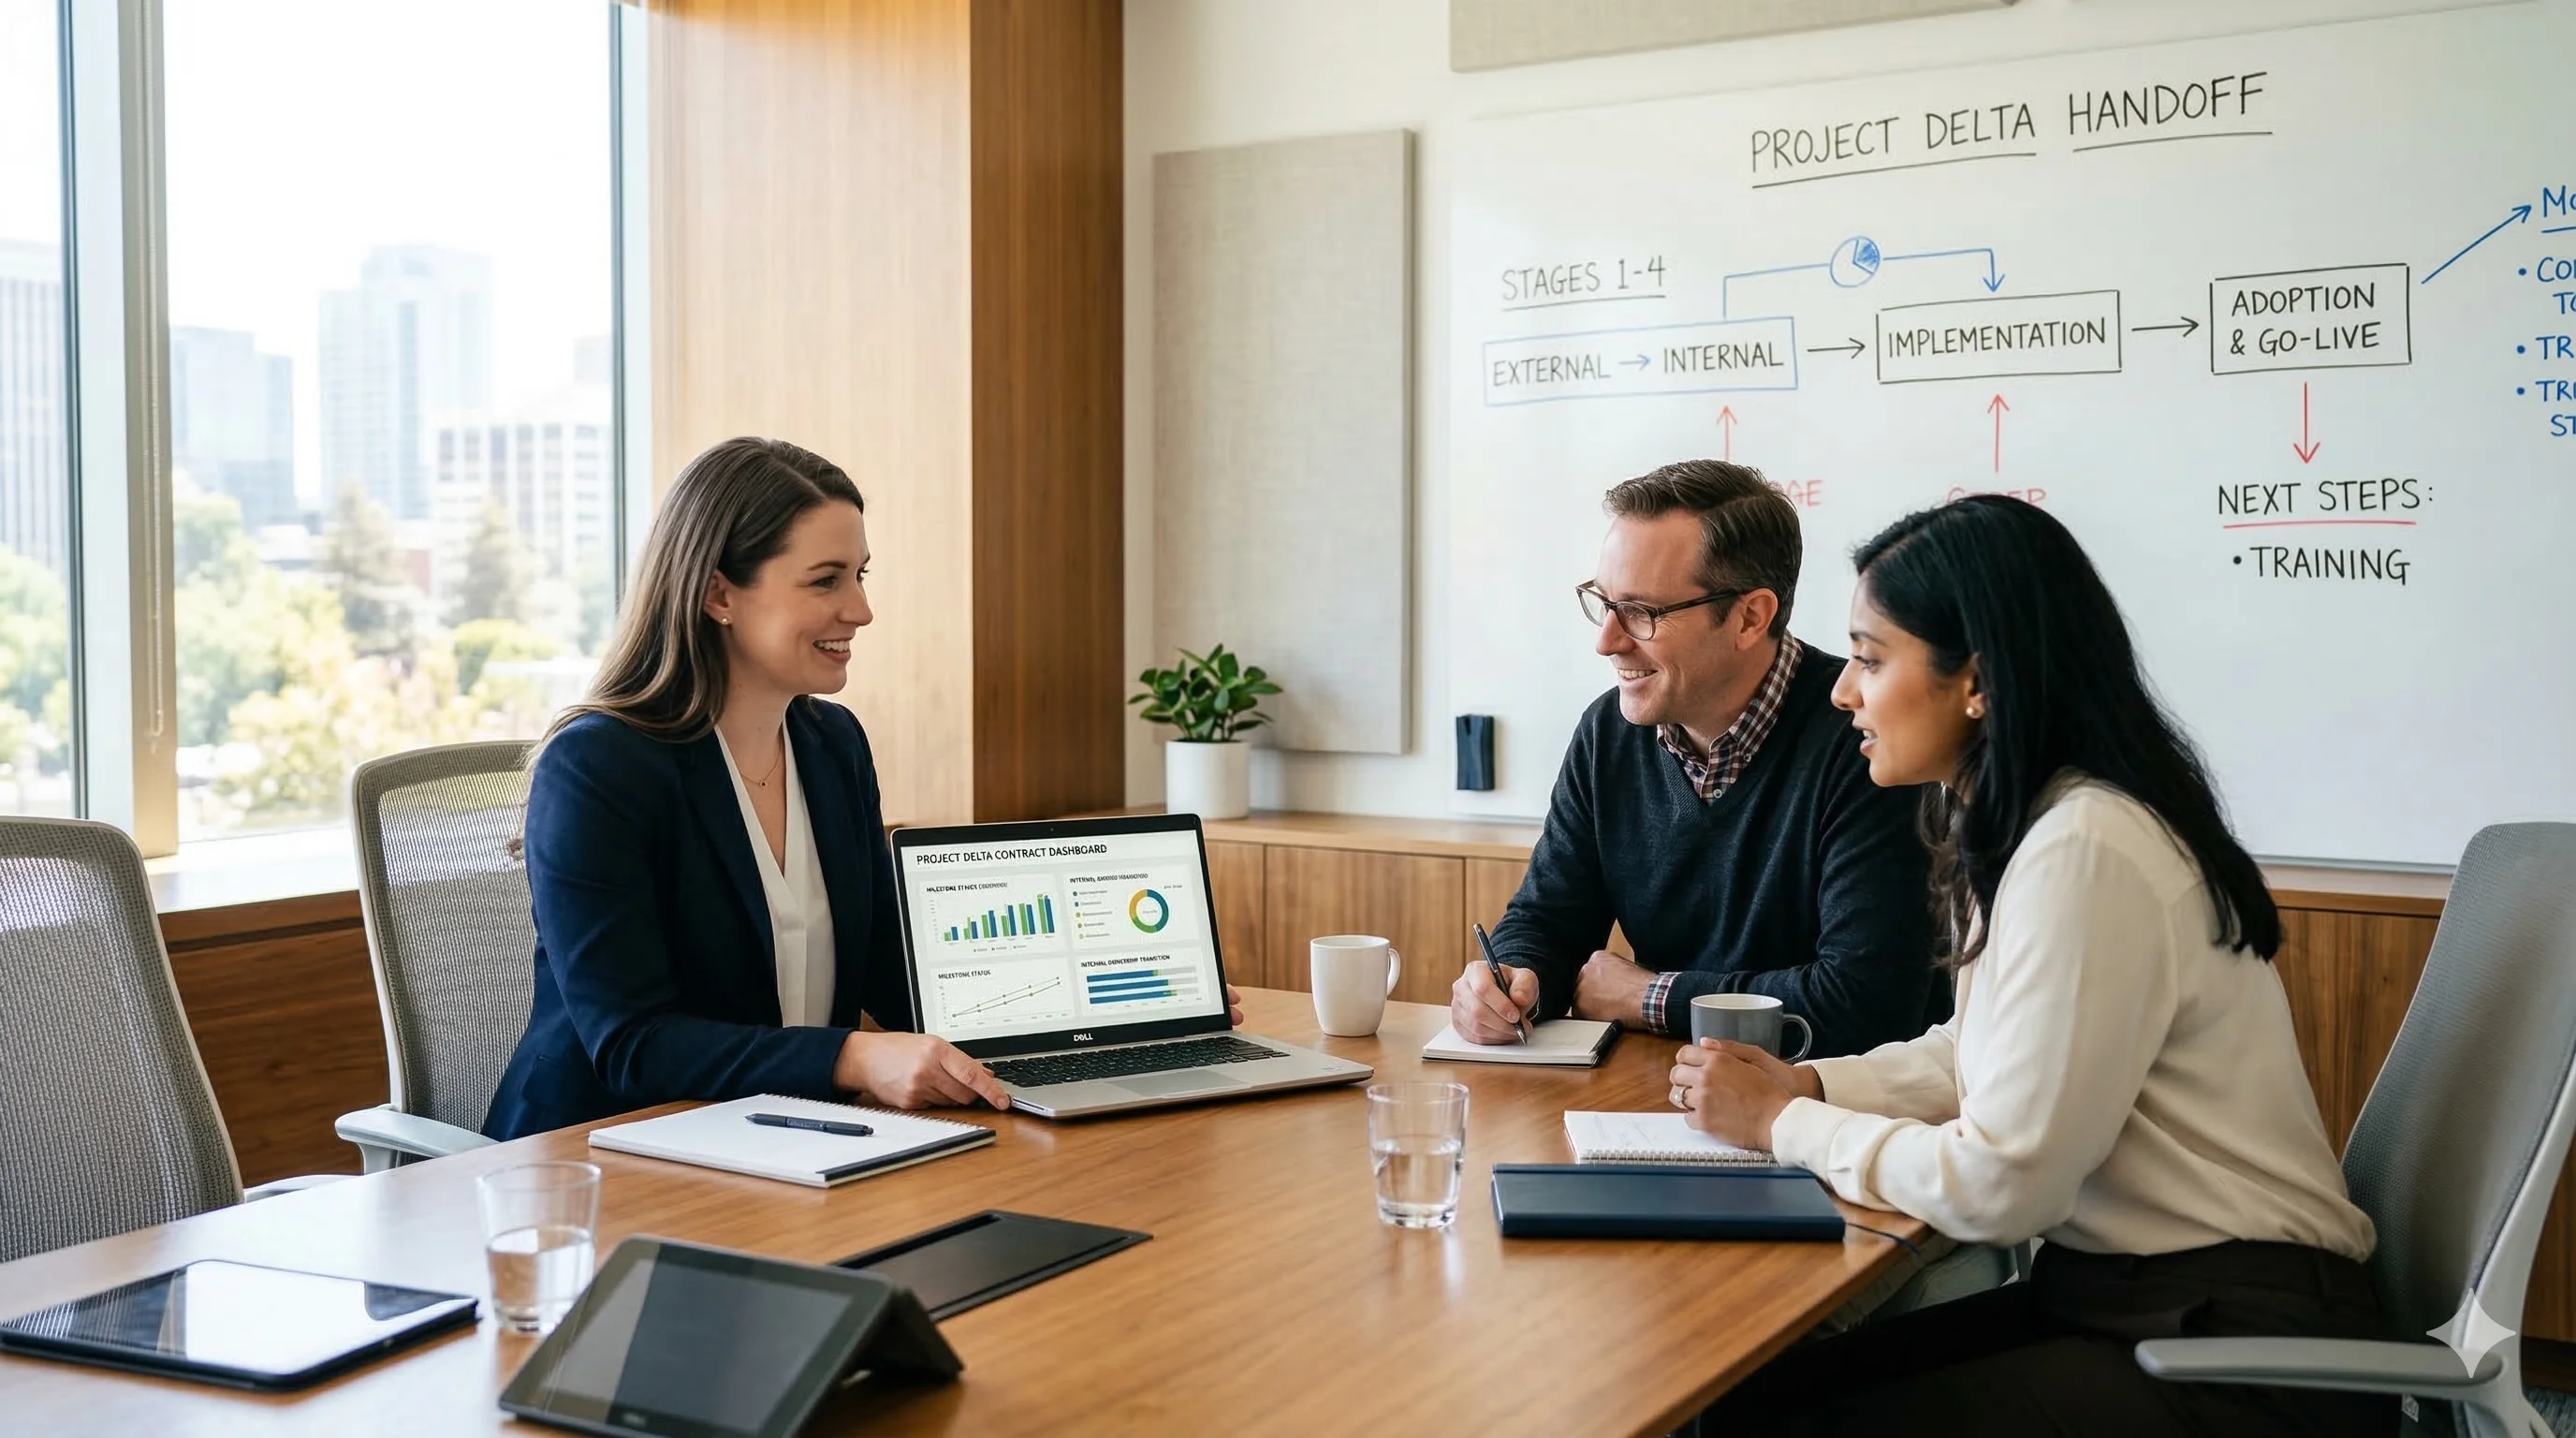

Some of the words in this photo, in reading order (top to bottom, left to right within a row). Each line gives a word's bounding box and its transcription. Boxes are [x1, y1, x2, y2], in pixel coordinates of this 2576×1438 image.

[1752, 116, 1899, 172] PROJECT
[1925, 103, 2036, 150] DELTA
[2069, 71, 2268, 136] HANDOFF
[1501, 261, 1602, 301] STAGES
[1617, 255, 1667, 290] 1-4
[2231, 281, 2375, 317] ADOPTION
[1888, 315, 2106, 359] IMPLEMENTATION
[2230, 328, 2246, 357] &
[2258, 321, 2381, 358] GO-LIVE
[1493, 353, 1612, 388] EXTERNAL
[1663, 341, 1785, 374] INTERNAL
[2217, 481, 2302, 517] NEXT
[2318, 477, 2434, 512] STEPS:
[2249, 546, 2411, 586] TRAINING
[916, 852, 960, 865] PROJECT
[963, 851, 993, 862] DELTA
[995, 847, 1046, 860] CONTRACT
[1048, 844, 1107, 857] DASHBOARD
